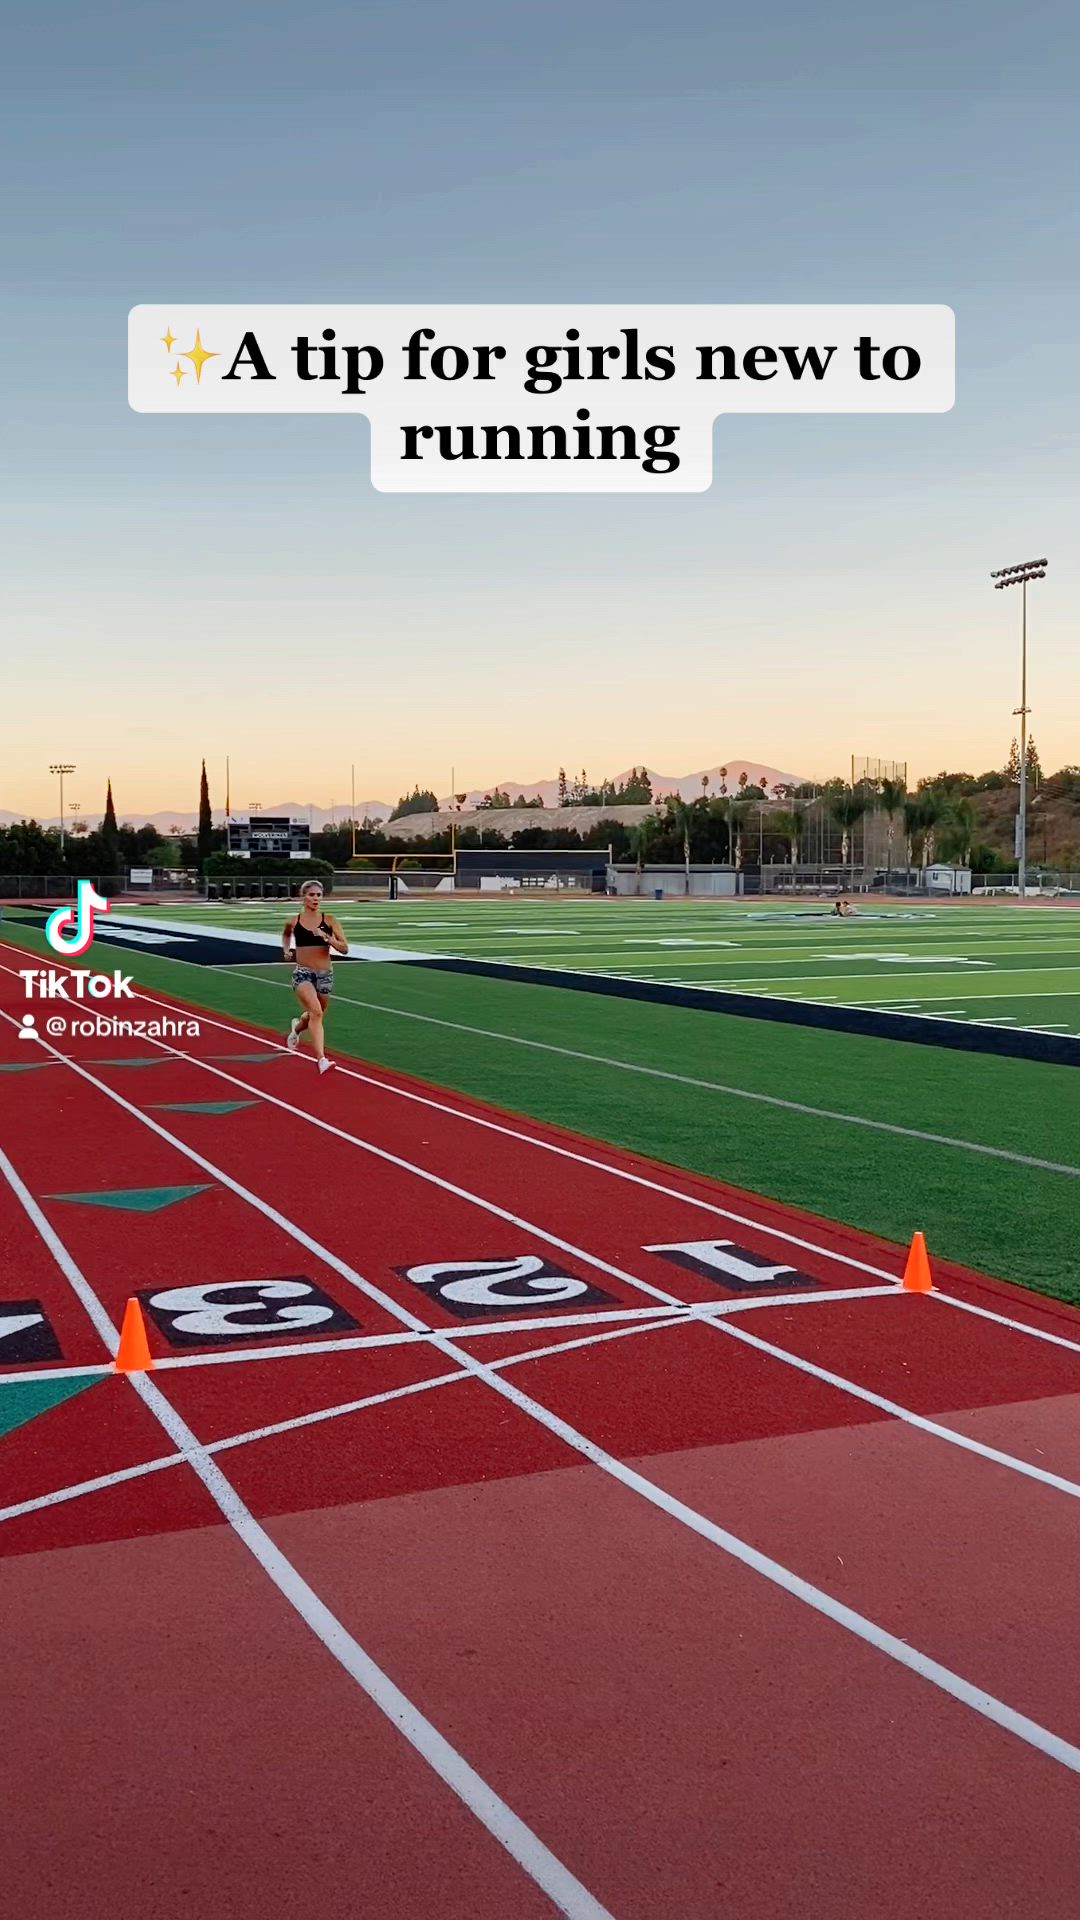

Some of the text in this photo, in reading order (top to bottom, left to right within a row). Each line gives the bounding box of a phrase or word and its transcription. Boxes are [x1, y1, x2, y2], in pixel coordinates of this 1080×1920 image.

[406, 1255, 588, 1306] 2
[640, 1239, 798, 1282] 1
[149, 1280, 334, 1335] 3
